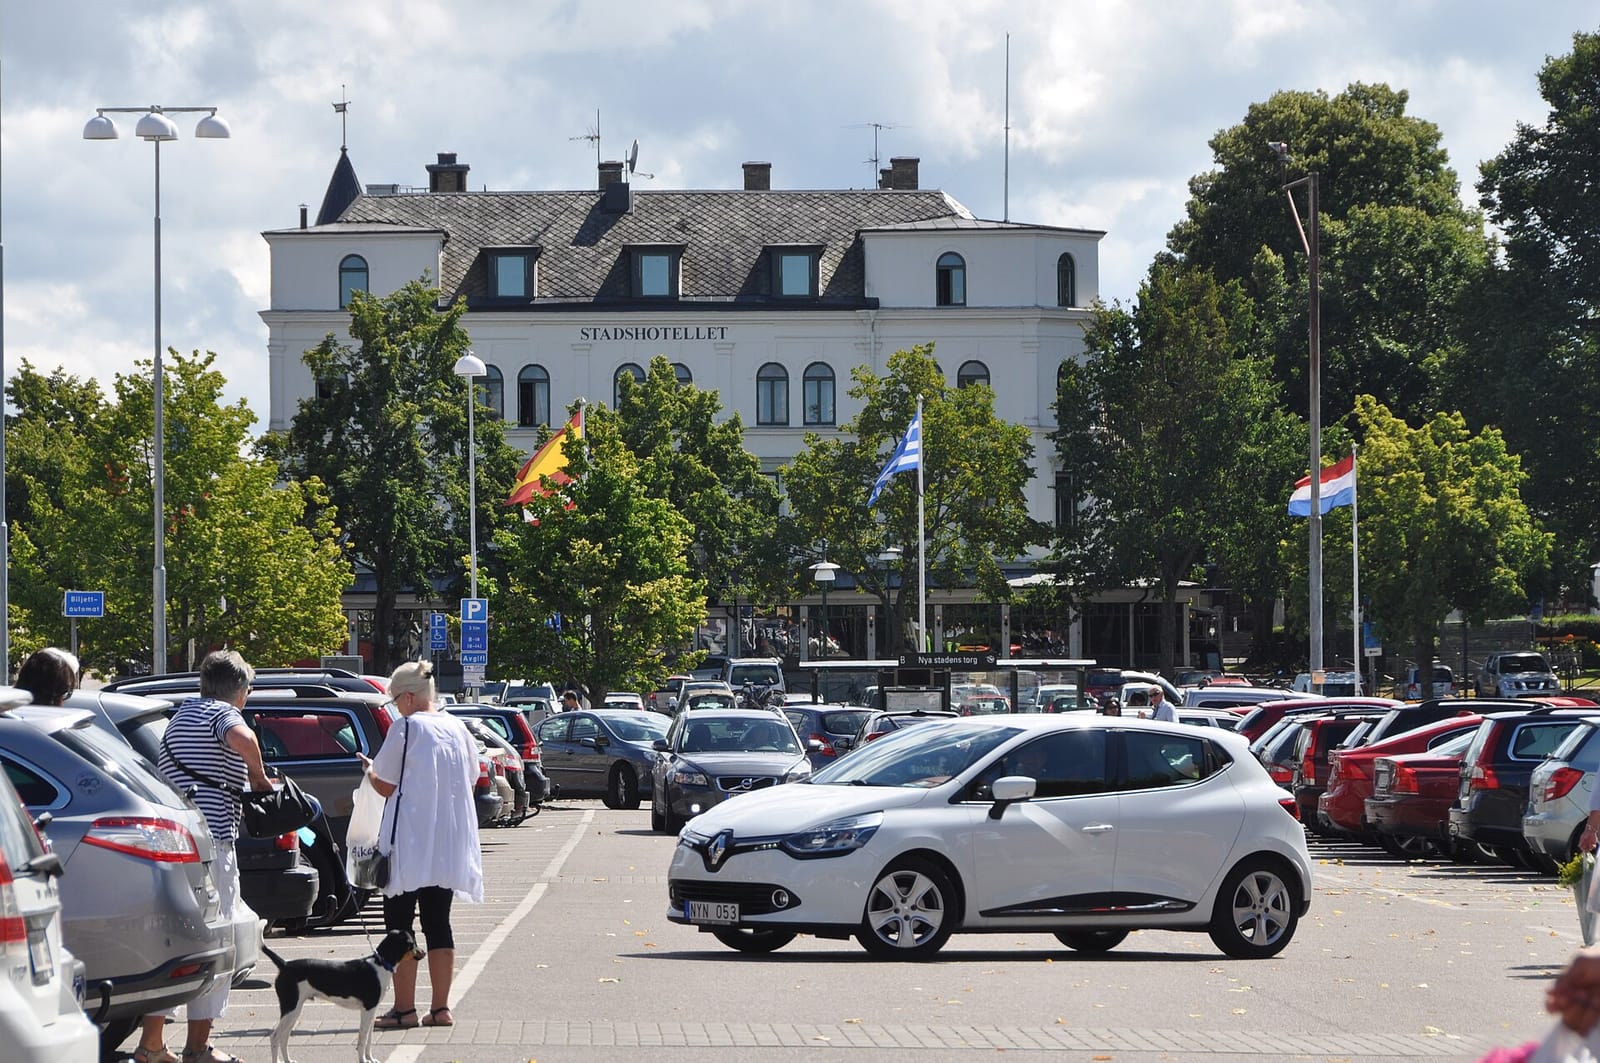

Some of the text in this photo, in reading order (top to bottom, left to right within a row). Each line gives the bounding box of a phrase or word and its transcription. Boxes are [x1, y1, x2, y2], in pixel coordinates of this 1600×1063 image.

[580, 326, 729, 341] STADSHOTELLET
[70, 595, 98, 604] Biljett-
[467, 601, 482, 619] P
[434, 615, 443, 626] P
[462, 655, 485, 663] Avgift
[900, 655, 978, 665] B Nya stadens torg
[690, 903, 737, 920] NYN 053
